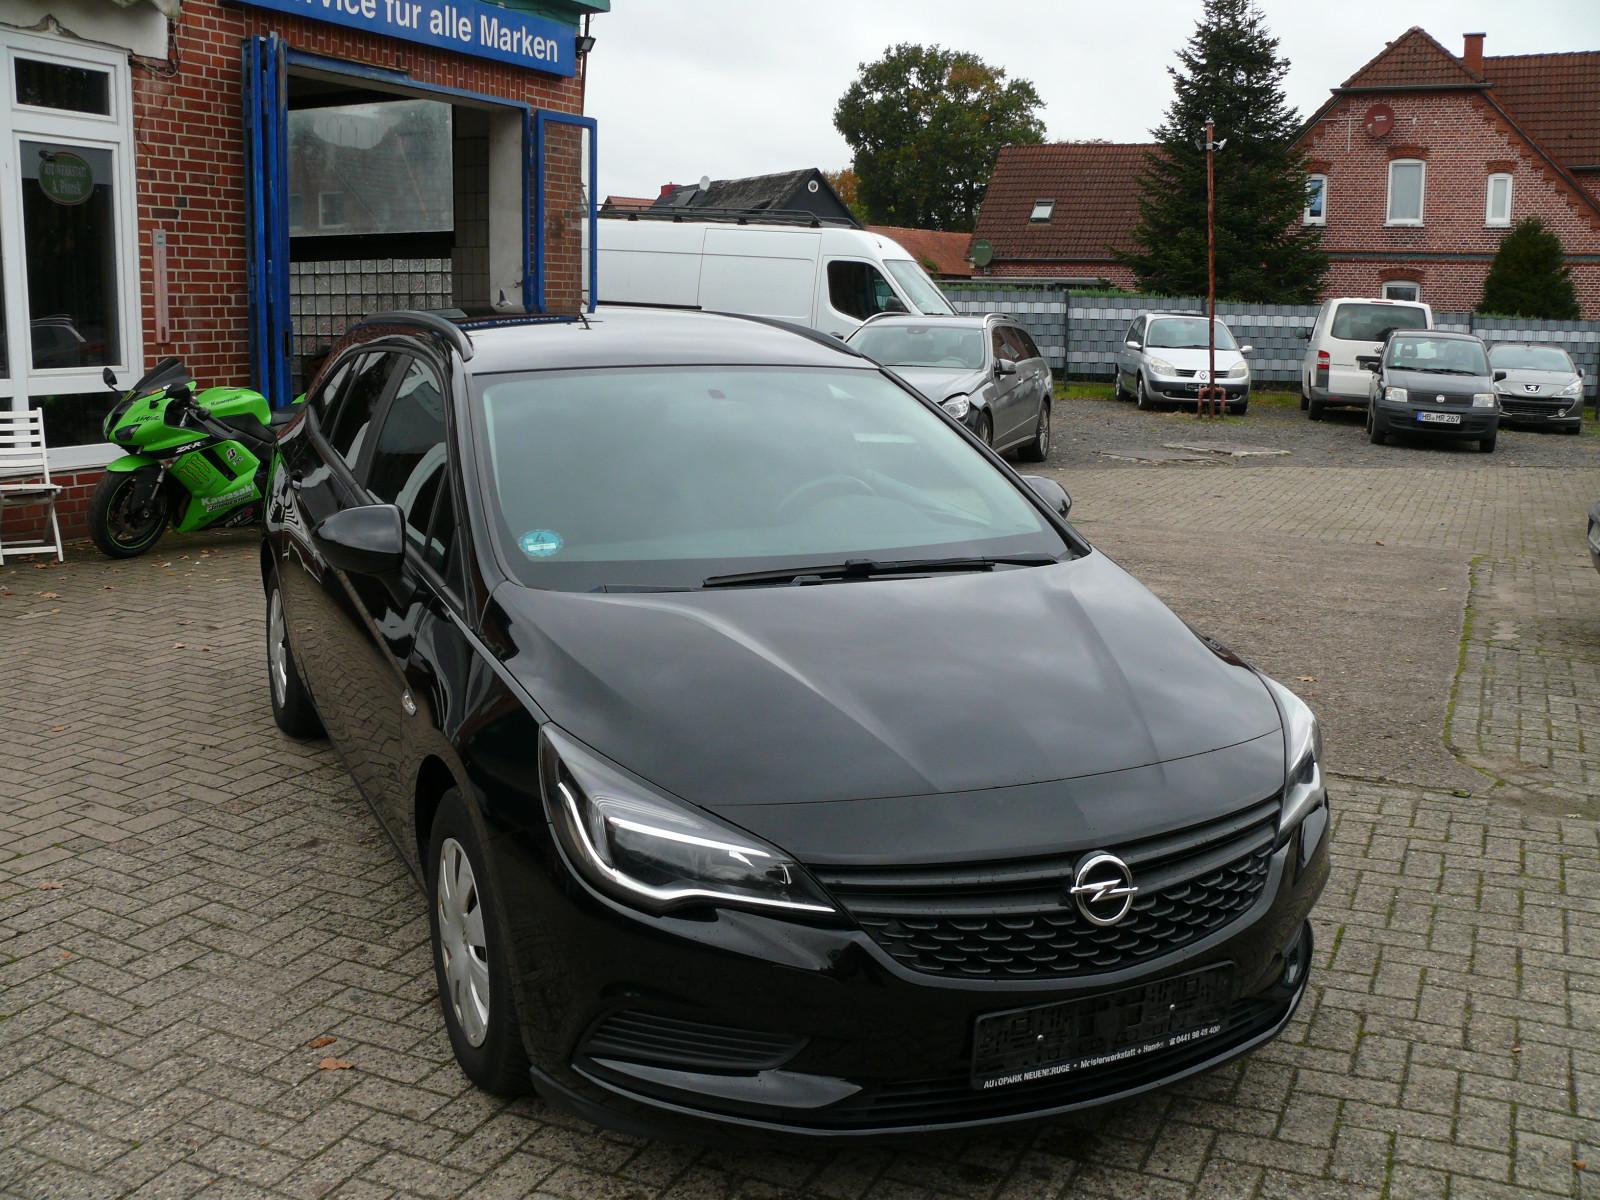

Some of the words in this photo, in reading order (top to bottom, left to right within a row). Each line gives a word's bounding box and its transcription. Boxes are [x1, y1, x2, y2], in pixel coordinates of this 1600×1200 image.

[430, 6, 472, 42] alle
[479, 14, 559, 63] Marken
[1446, 415, 1460, 423] 267
[201, 483, 256, 505] Kawasaki
[1176, 1031, 1190, 1044] 0441
